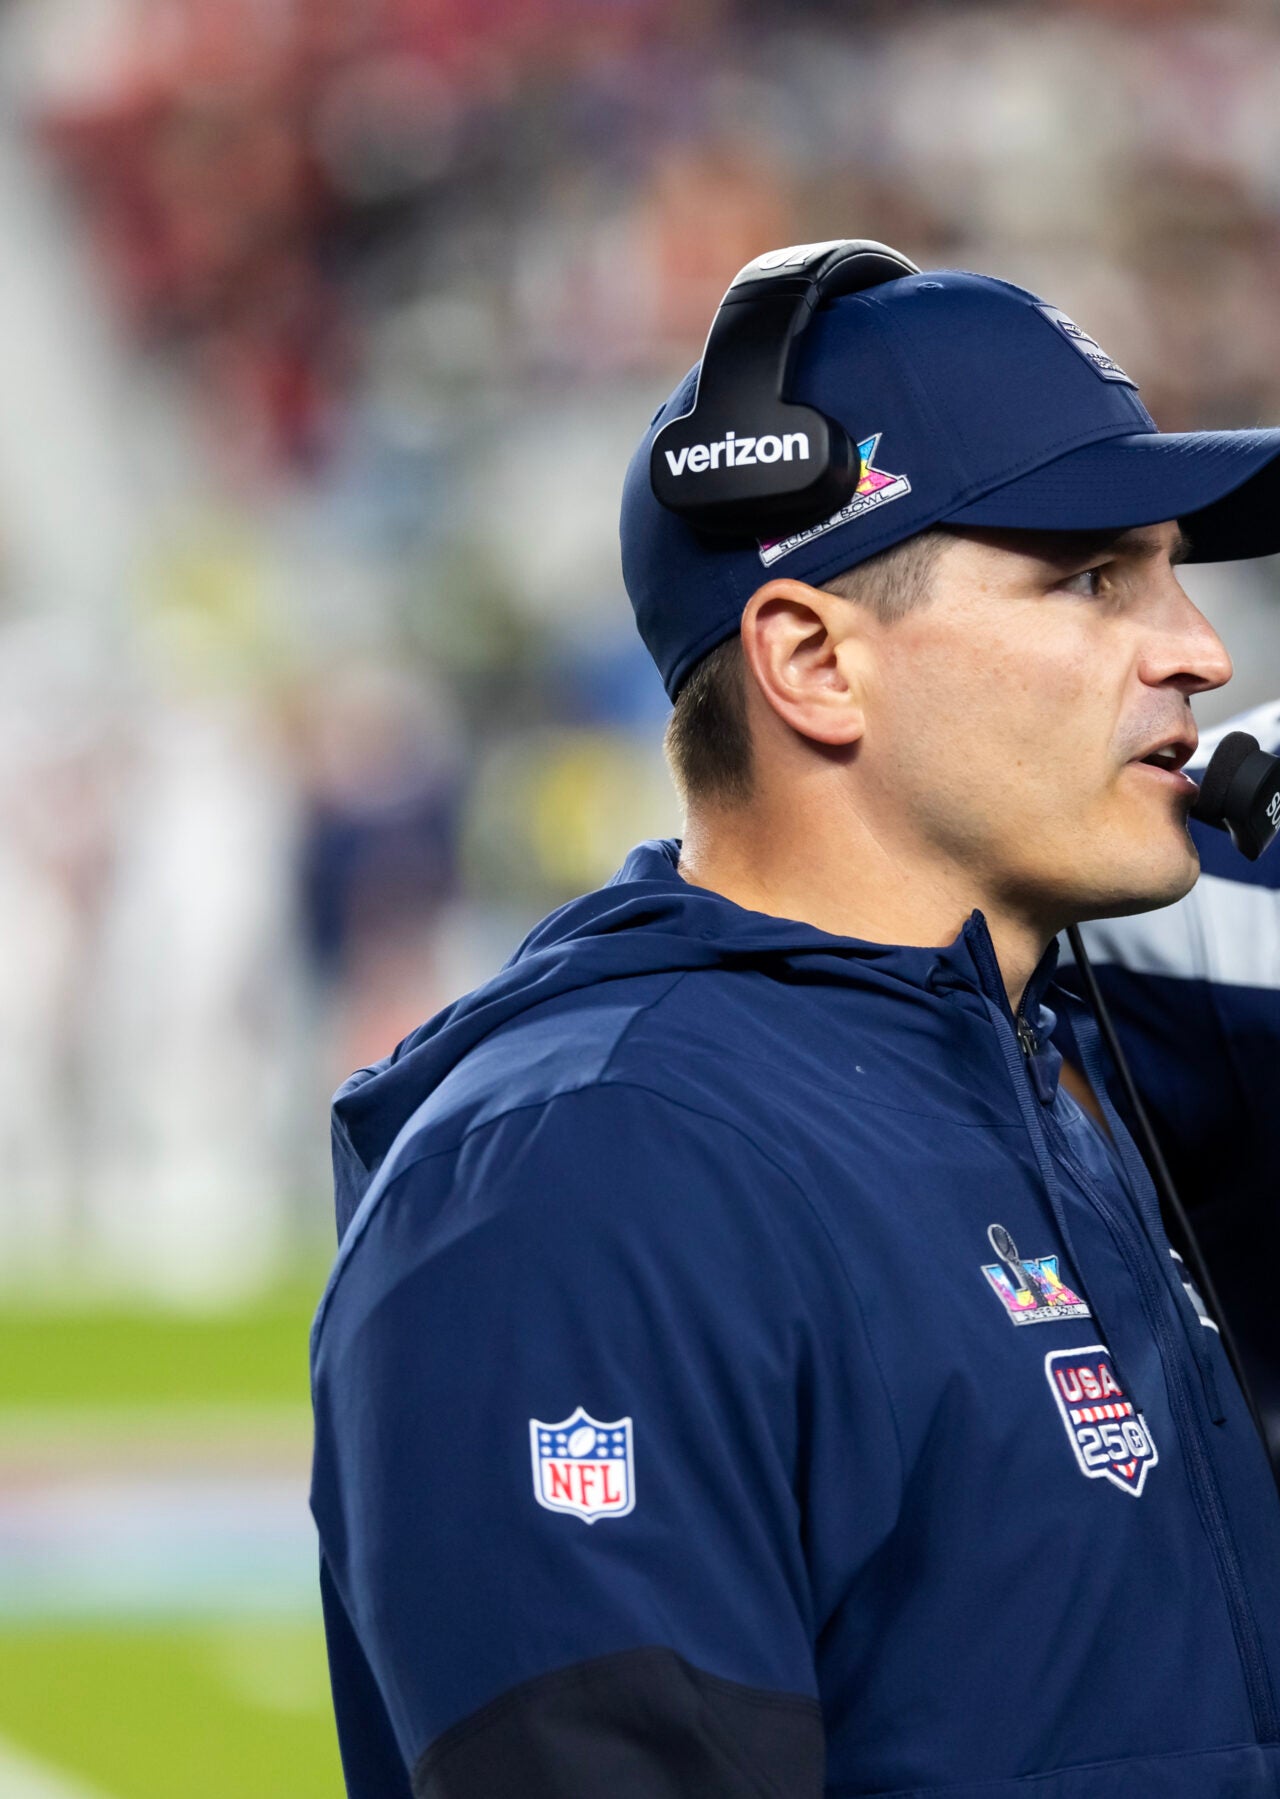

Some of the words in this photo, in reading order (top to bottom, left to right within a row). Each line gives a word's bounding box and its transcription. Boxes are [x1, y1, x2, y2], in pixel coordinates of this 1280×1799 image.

[664, 431, 810, 477] verizon
[840, 492, 890, 519] BOWL
[1054, 1363, 1123, 1403] USA
[1076, 1420, 1151, 1466] 250
[548, 1462, 621, 1507] NFL
